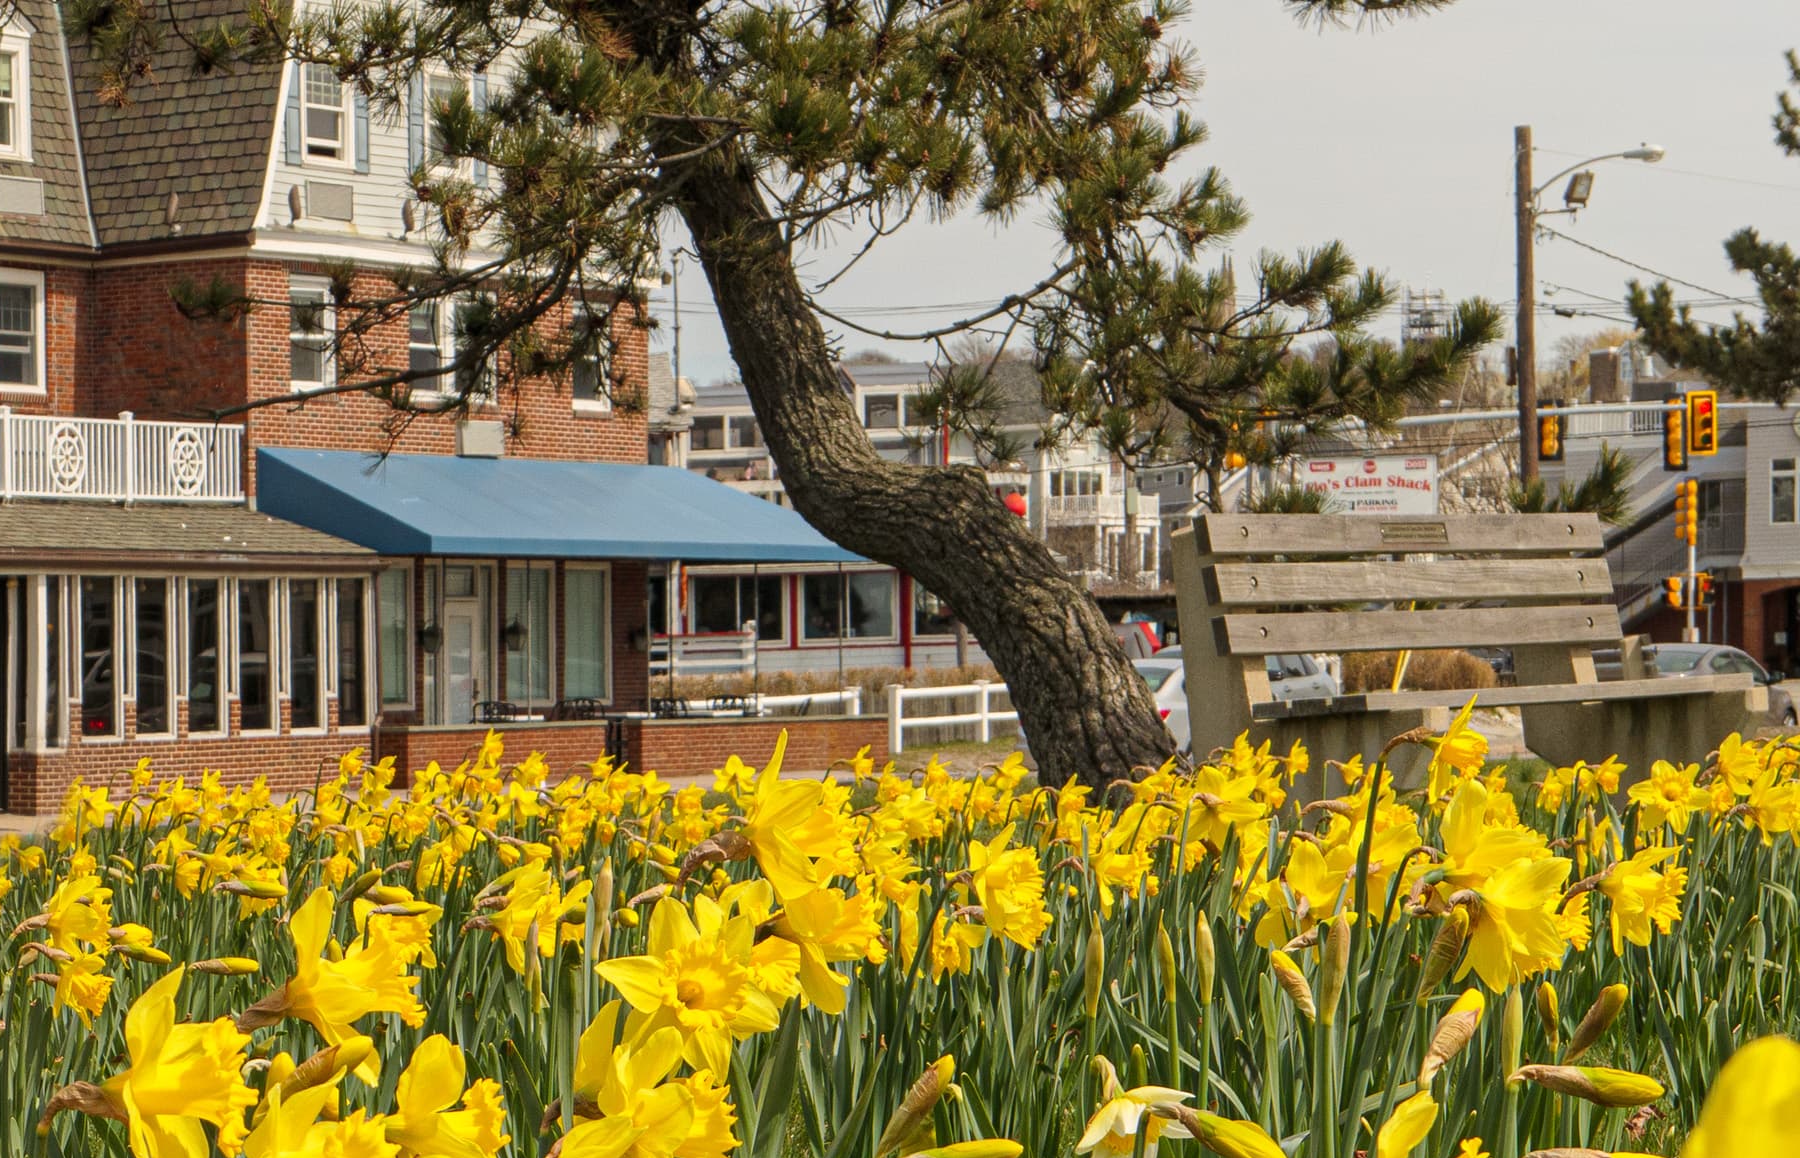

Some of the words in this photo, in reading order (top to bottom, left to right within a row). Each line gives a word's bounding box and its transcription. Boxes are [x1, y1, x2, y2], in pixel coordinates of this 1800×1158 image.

[1344, 475, 1382, 488] Clam
[1387, 474, 1432, 492] Shack
[1356, 498, 1398, 506] PARKING
